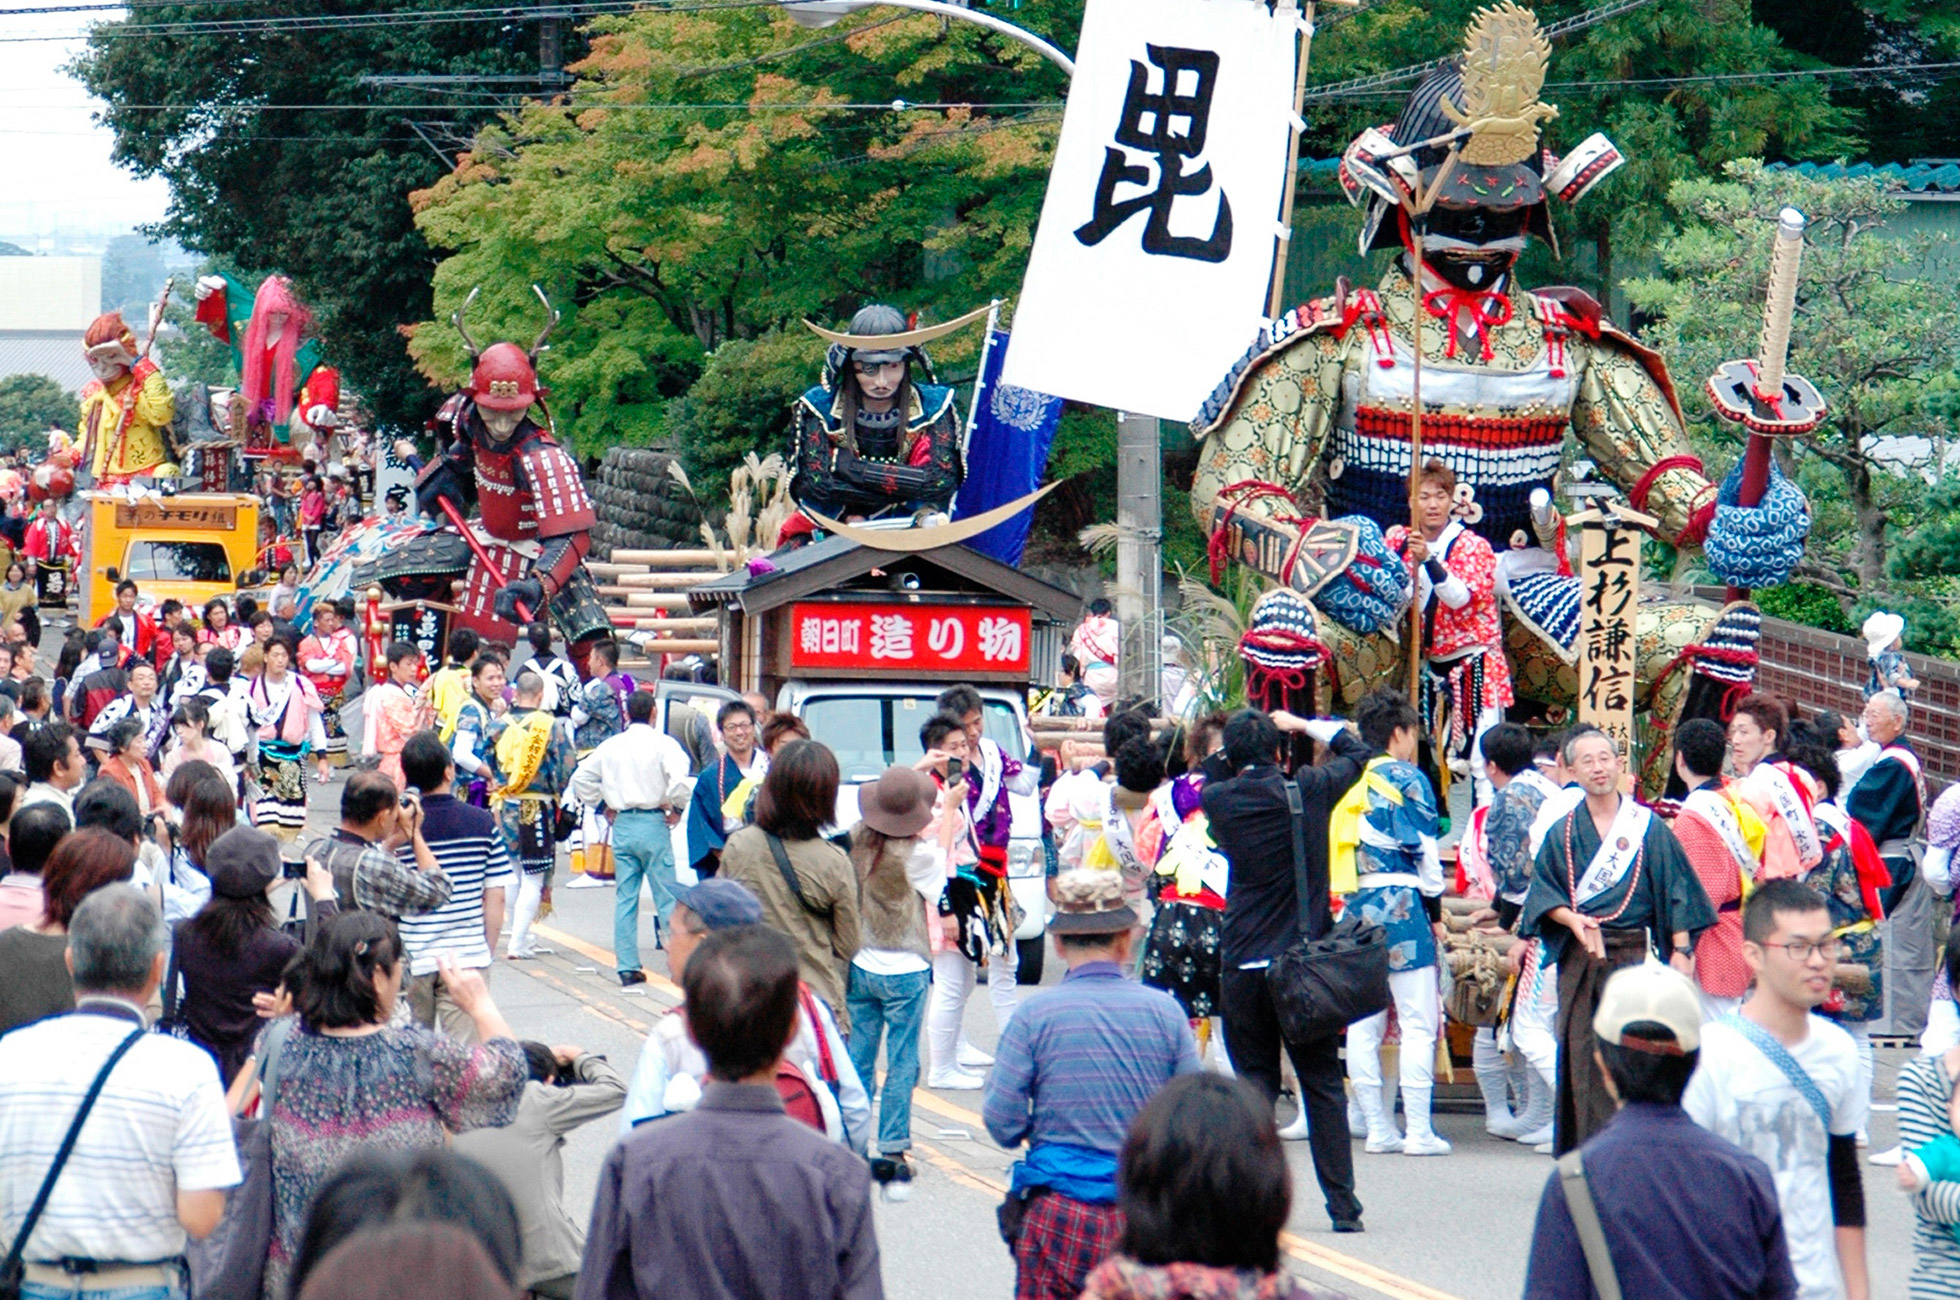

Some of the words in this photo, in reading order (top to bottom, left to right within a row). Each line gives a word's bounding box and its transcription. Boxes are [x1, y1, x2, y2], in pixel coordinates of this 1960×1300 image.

[1073, 42, 1234, 264] 毘
[801, 618, 862, 655] 朝日町
[869, 614, 1022, 662] 造り物
[1583, 528, 1634, 711] 上杉謙信
